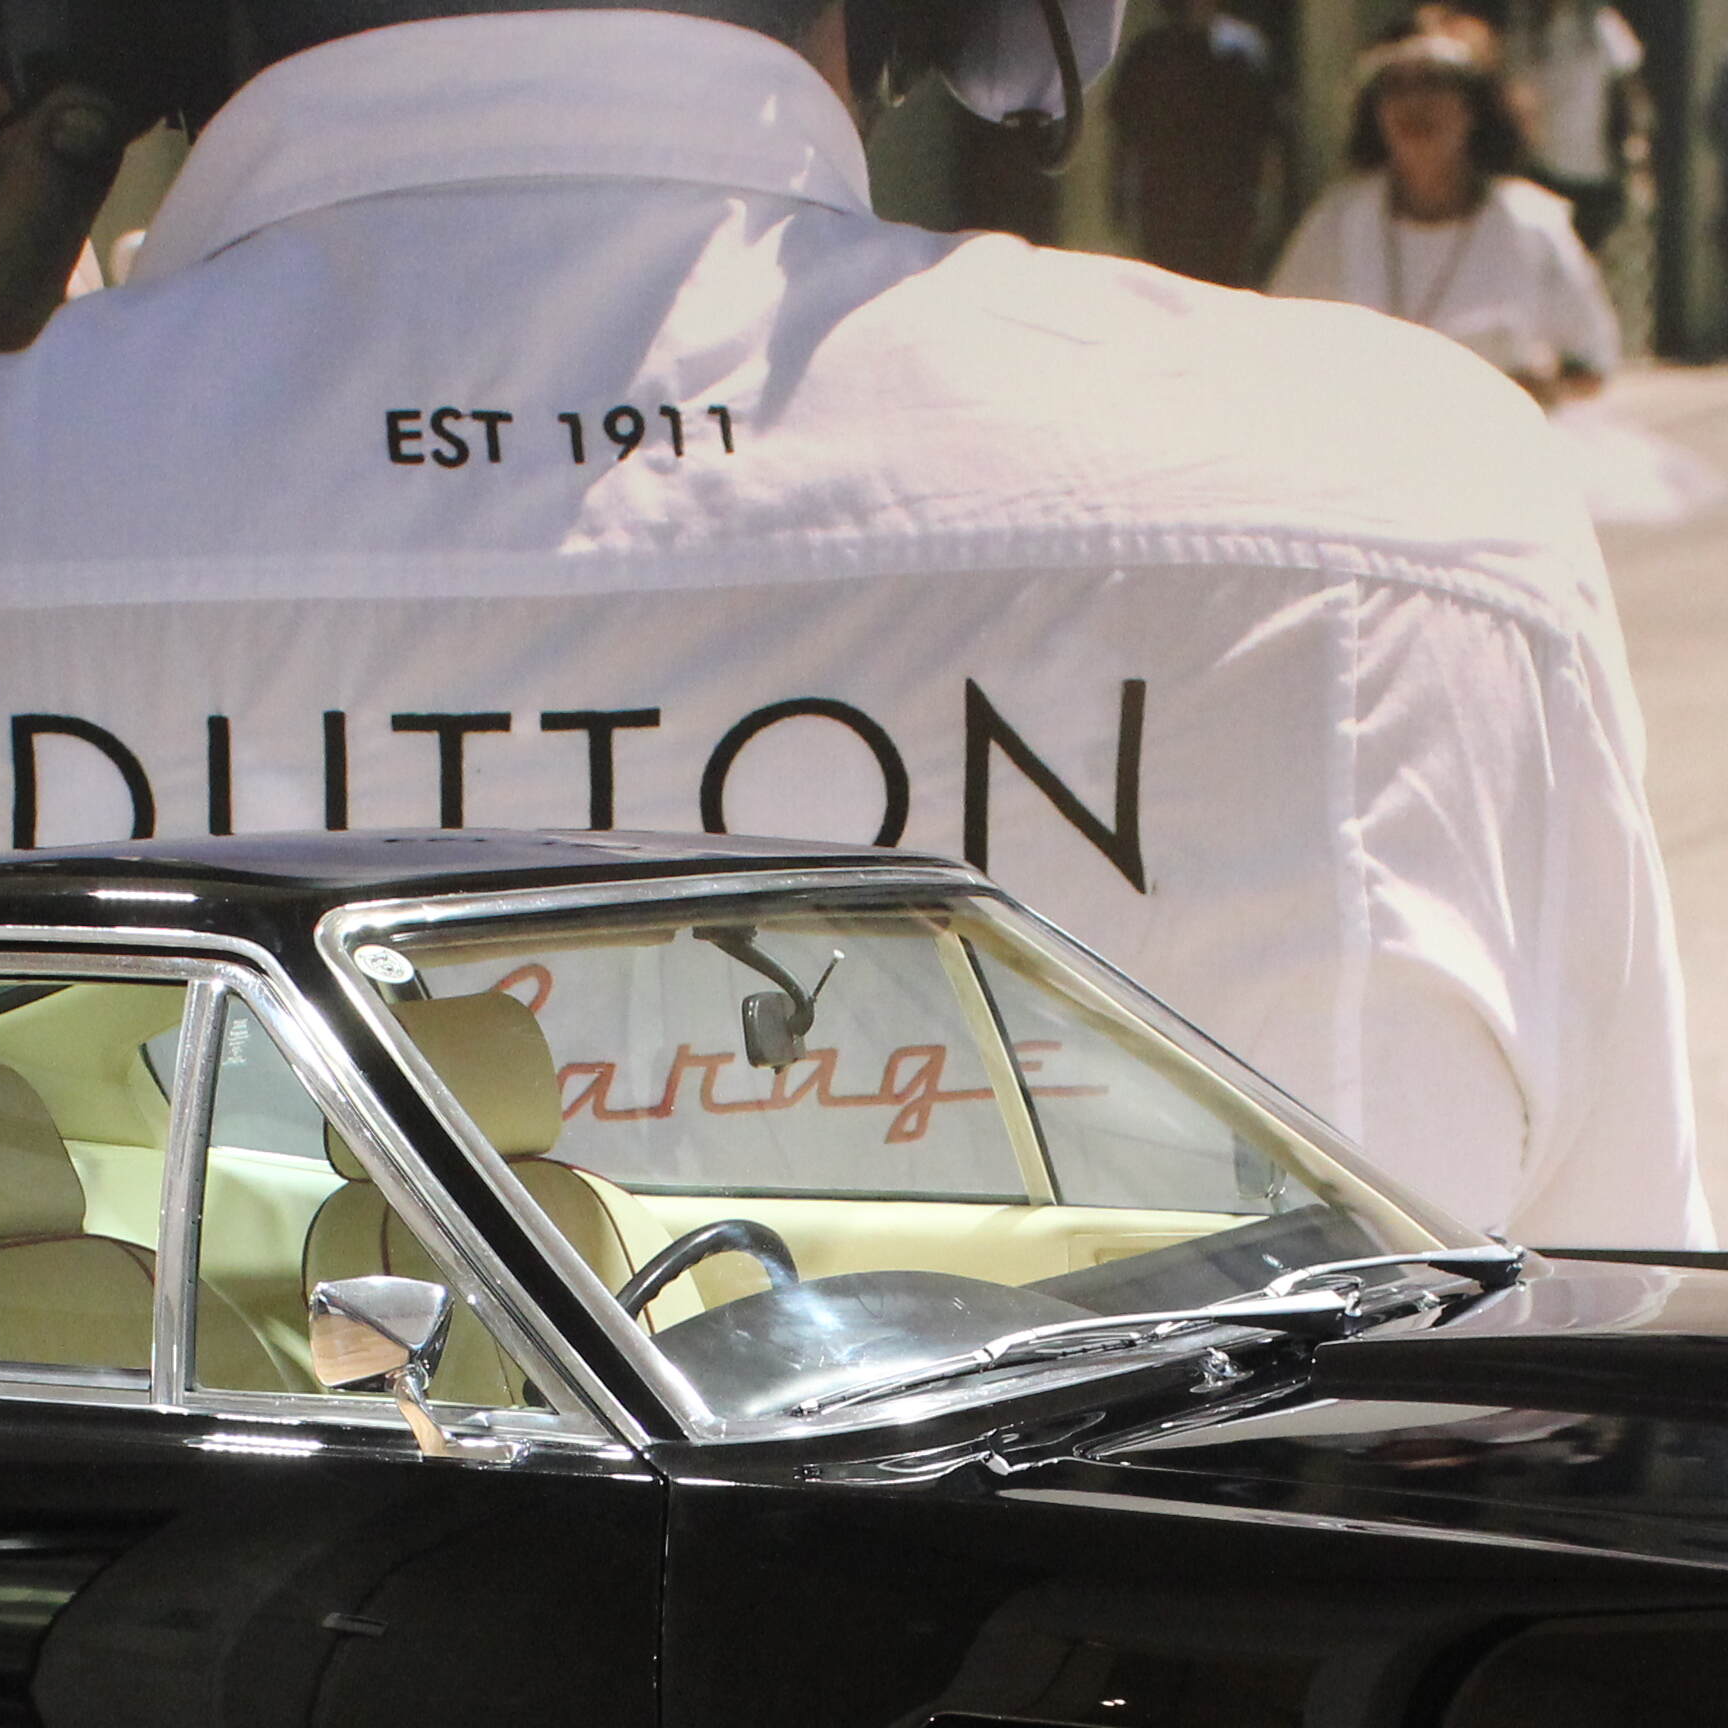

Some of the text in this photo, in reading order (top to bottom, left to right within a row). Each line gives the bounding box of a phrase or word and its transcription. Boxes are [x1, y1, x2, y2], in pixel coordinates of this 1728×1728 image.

[385, 405, 735, 468] EST 1911
[11, 679, 1148, 895] DUTTON
[495, 962, 1109, 1145] arage
